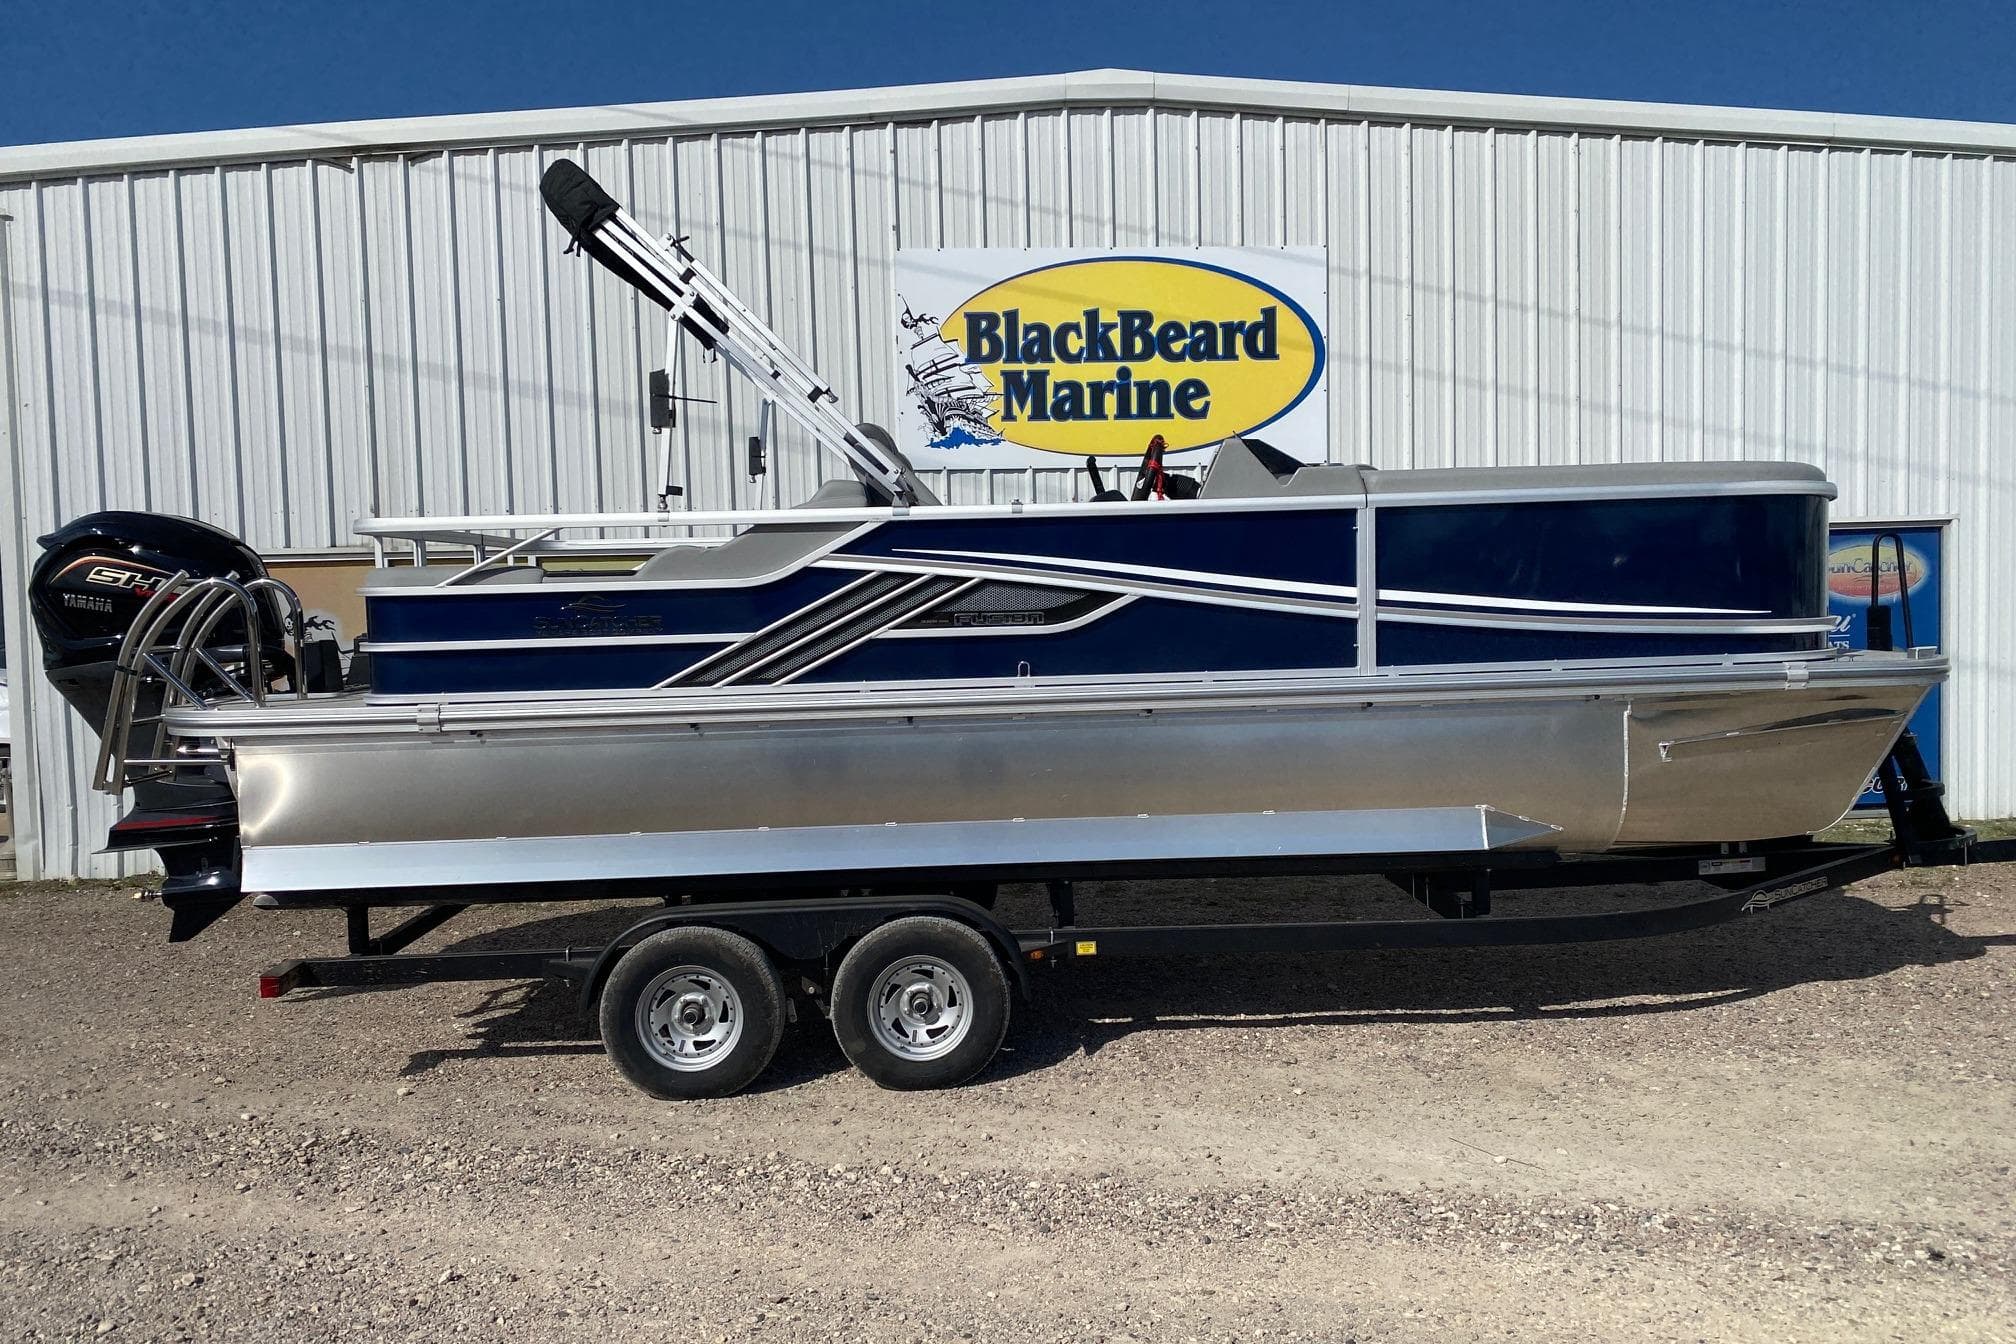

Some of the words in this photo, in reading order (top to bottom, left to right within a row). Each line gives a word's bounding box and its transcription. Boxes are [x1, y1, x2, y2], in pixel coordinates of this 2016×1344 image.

[963, 306, 1280, 364] BlackBeard
[1000, 366, 1211, 422] Marine
[62, 592, 113, 614] YAMAHA
